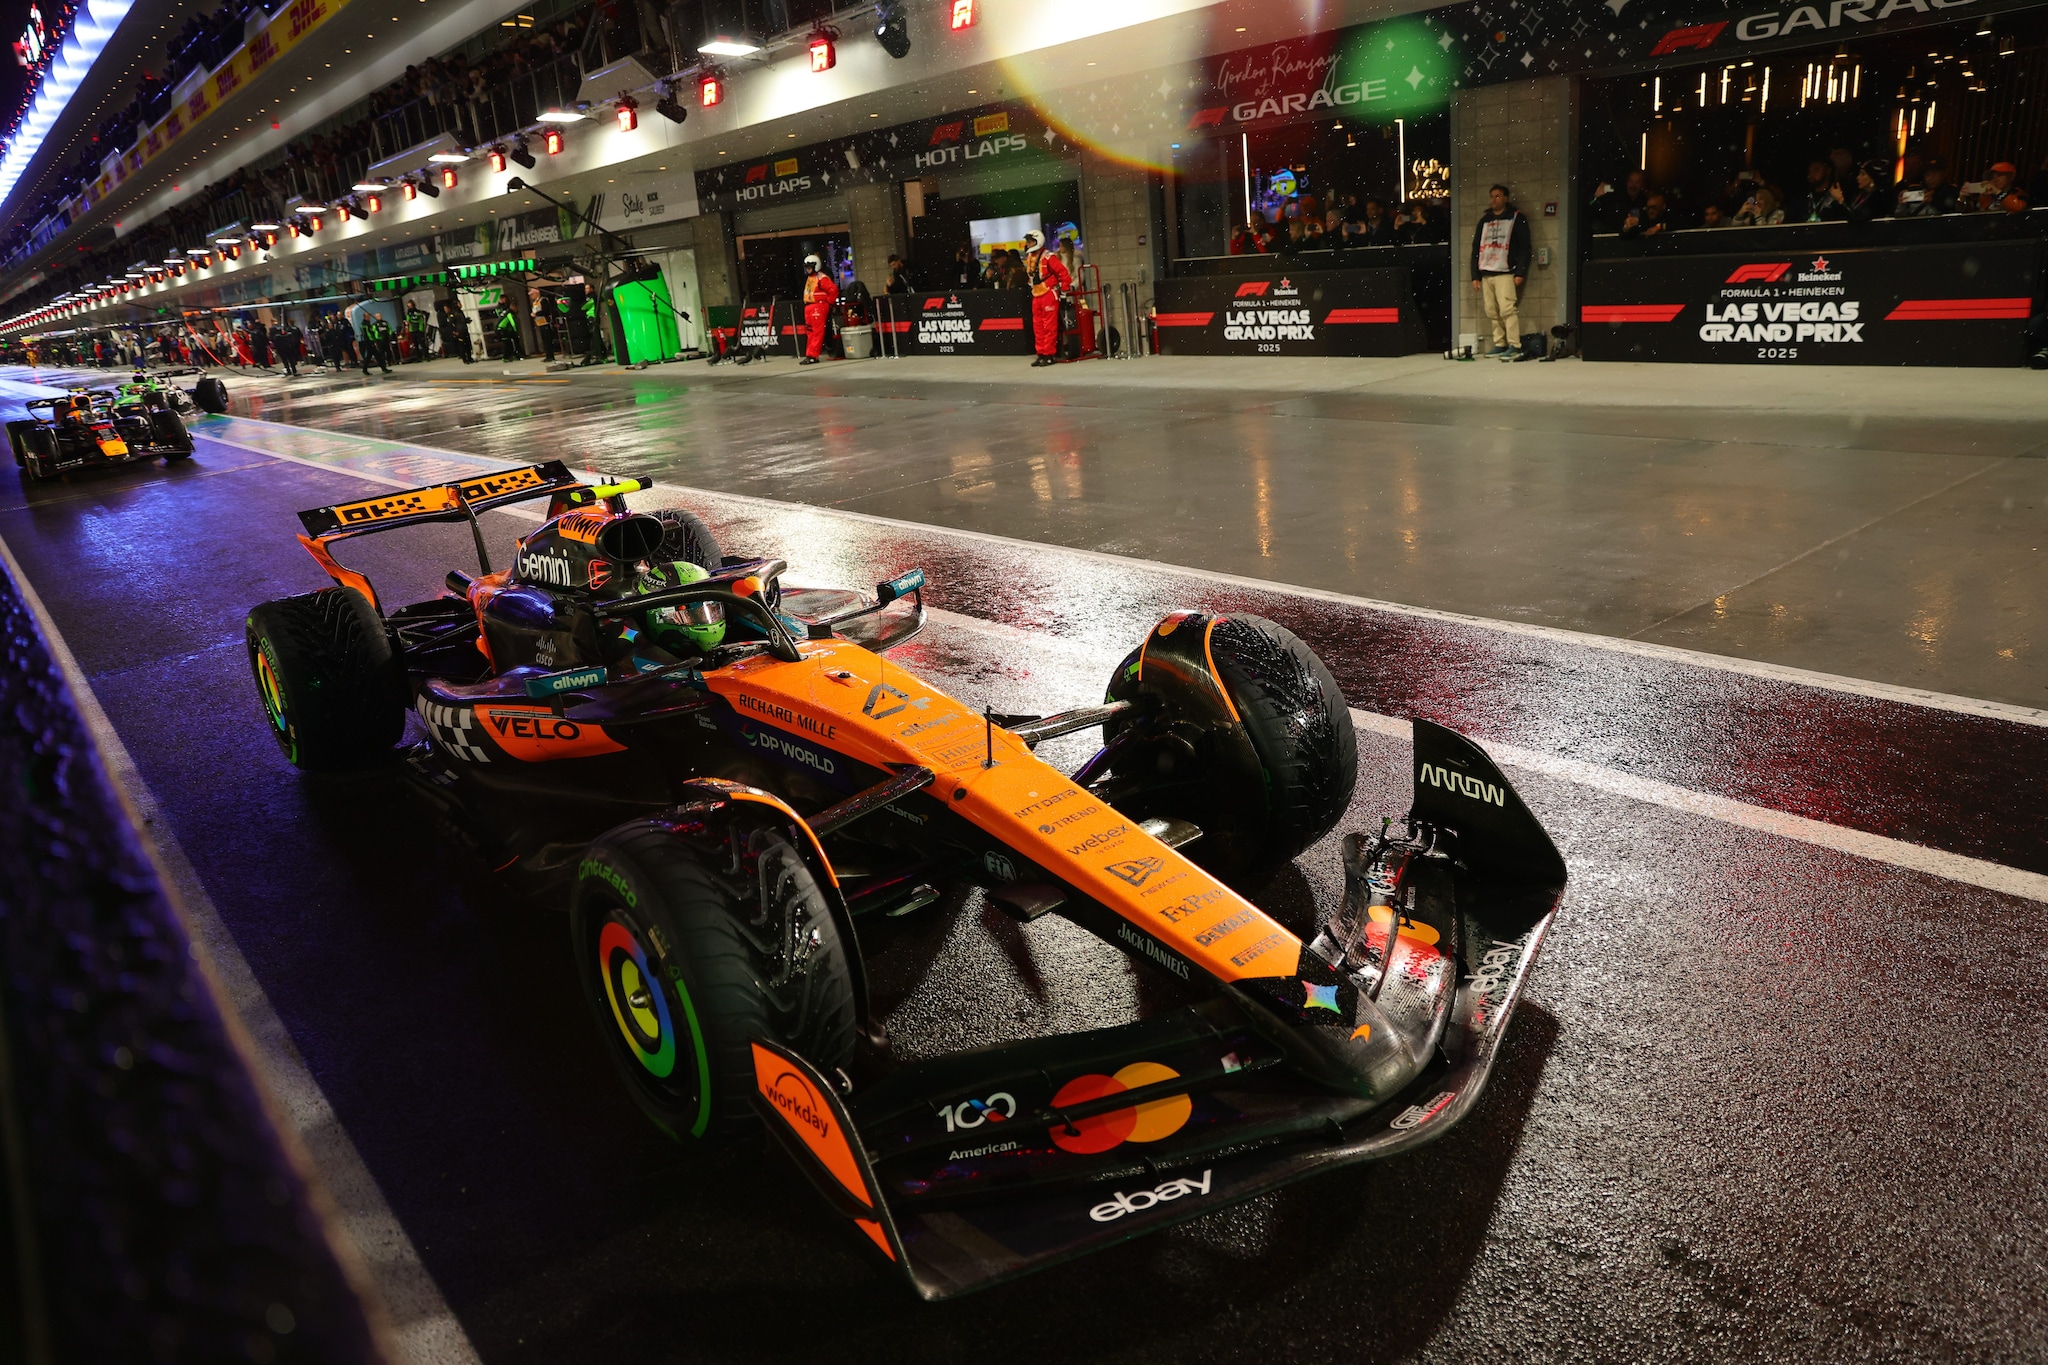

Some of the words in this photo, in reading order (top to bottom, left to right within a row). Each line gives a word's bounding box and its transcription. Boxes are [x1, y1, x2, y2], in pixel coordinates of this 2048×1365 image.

[1735, 0, 1978, 42] GARA
[1217, 58, 1266, 97] Gordon
[1271, 45, 1342, 95] Ramsay
[1254, 79, 1270, 97] at
[1232, 79, 1386, 122] GARAGE
[915, 147, 960, 168] HOT
[964, 134, 1027, 160] LAPS
[736, 187, 764, 201] HOT
[769, 176, 811, 195] LAPS
[622, 193, 644, 217] Stake
[501, 218, 517, 250] 27
[434, 236, 443, 263] 5
[1797, 272, 1842, 282] Heineken
[479, 288, 500, 305] 27
[1270, 299, 1301, 307] HEINEKEN
[1720, 288, 1770, 298] FORMULA
[1773, 288, 1779, 297] 1
[1788, 287, 1845, 297] HEINEKEN
[1225, 310, 1256, 325] LAS
[1256, 309, 1310, 325] VEGAS
[1706, 303, 1759, 322] LAS
[1762, 301, 1859, 322] VEGAS
[918, 320, 938, 332] LAS
[938, 319, 971, 331] VEGAS
[918, 331, 950, 343] GRAND
[951, 331, 974, 343] PRIX
[1223, 325, 1276, 340] GRAND
[1277, 325, 1315, 340] PRIX
[1699, 323, 1793, 342] GRAND
[1796, 322, 1865, 342] PRIX
[1257, 343, 1280, 352] 2025
[1757, 348, 1798, 358] 2025
[517, 542, 571, 586] Gemini
[536, 652, 553, 666] CISCO
[552, 673, 599, 690] allwyn
[490, 715, 580, 740] VELO
[739, 693, 793, 724] RICHARD
[797, 713, 837, 741] MILLE
[759, 732, 780, 750] DP
[779, 740, 835, 775] WORLD
[1420, 762, 1505, 807] ARROW
[883, 803, 924, 826] cLaren
[1014, 803, 1042, 818] NTT
[1052, 805, 1098, 828] TREND
[1066, 824, 1132, 856] webex
[1158, 888, 1226, 924] FxPro
[1117, 923, 1145, 951] JACK
[1146, 937, 1191, 980] DANIEL'S
[1464, 940, 1523, 993] ebay
[765, 1083, 829, 1139] workday
[937, 1091, 1016, 1133] 100
[949, 1140, 1017, 1161] American
[1089, 1169, 1212, 1223] ebay
